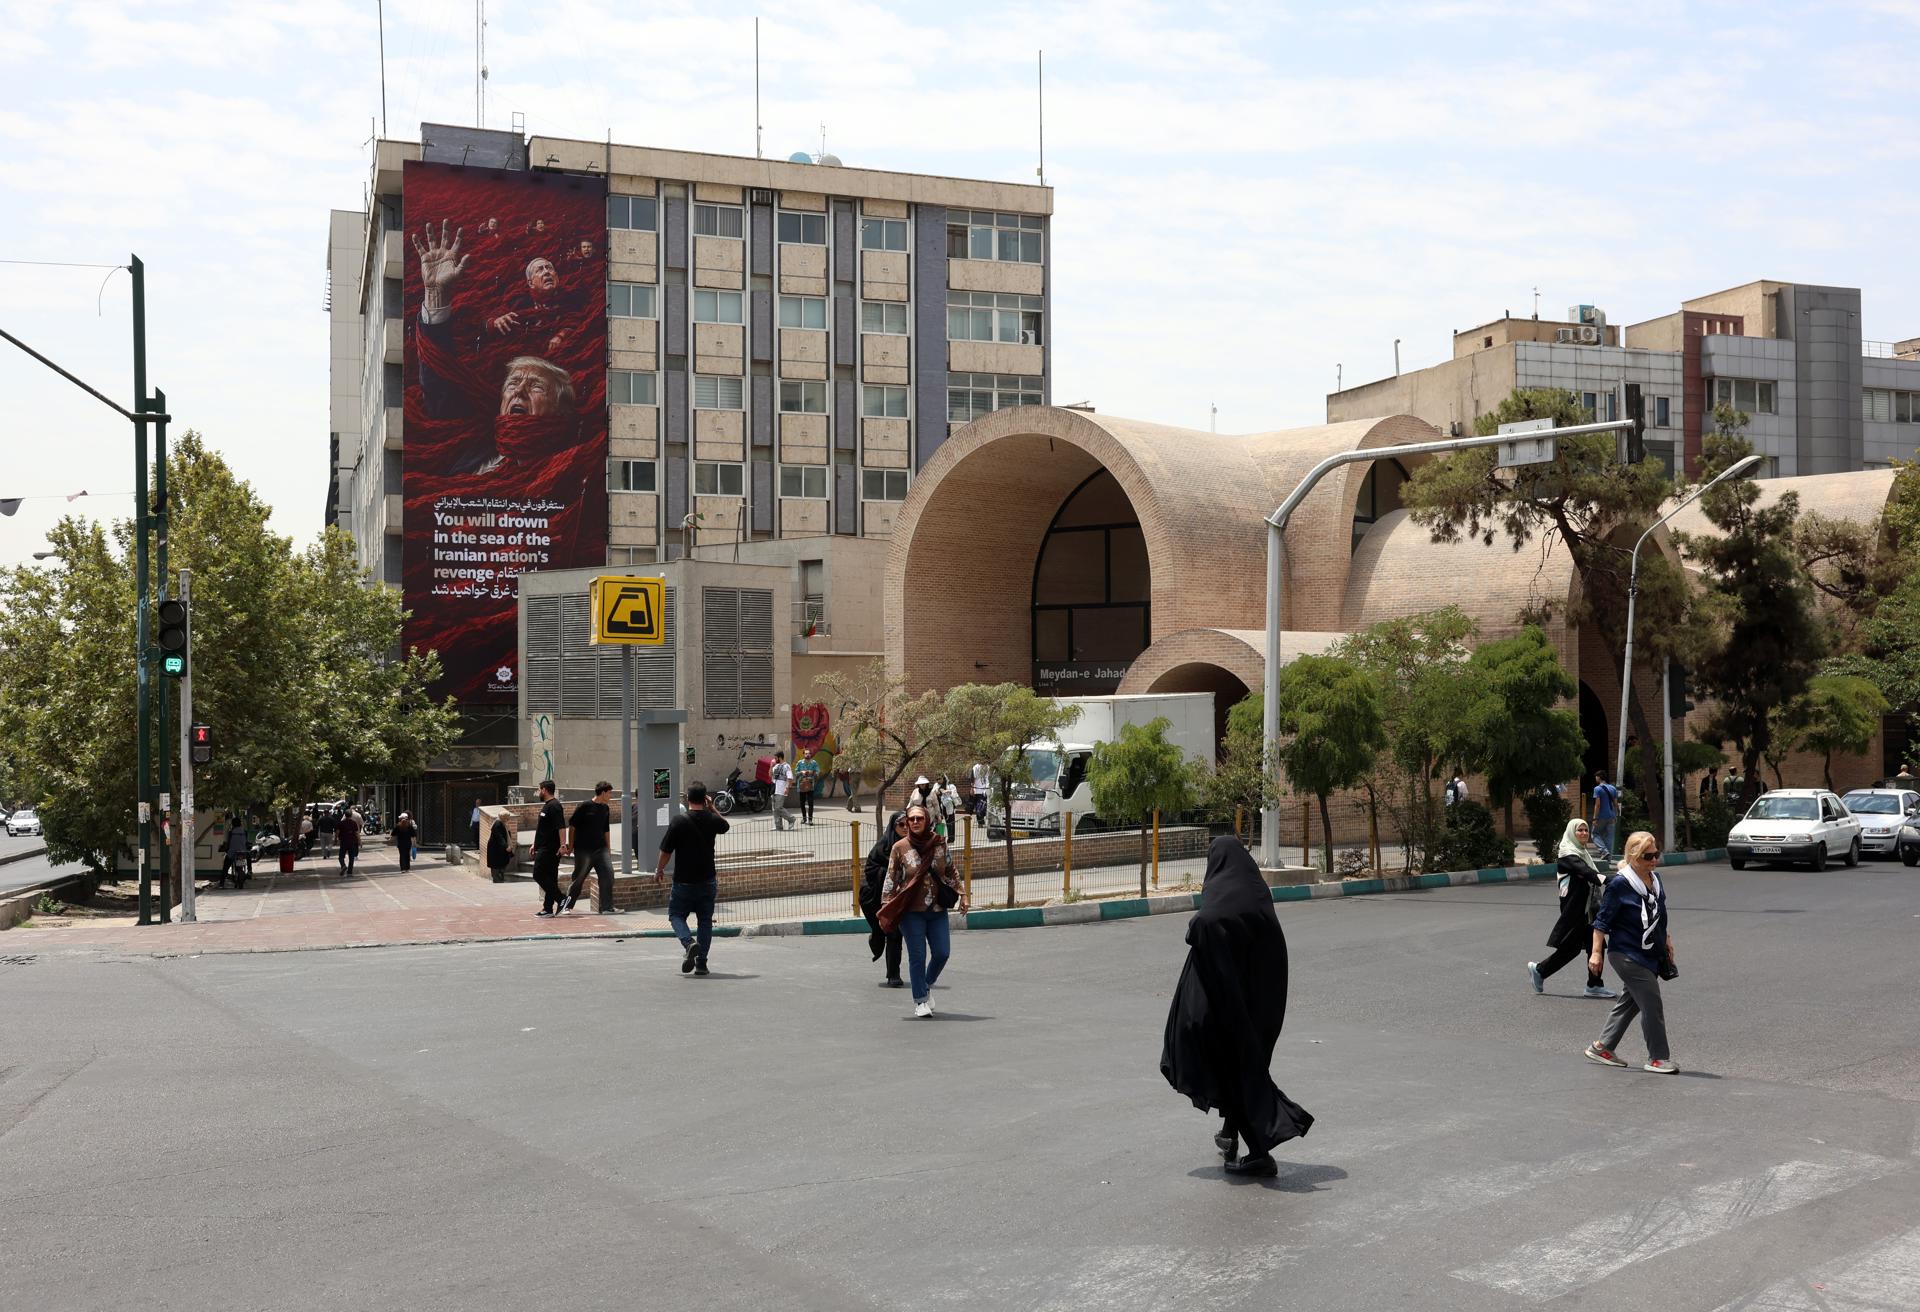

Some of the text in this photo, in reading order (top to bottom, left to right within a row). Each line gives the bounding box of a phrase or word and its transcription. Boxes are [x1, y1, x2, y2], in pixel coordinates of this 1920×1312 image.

[460, 498, 487, 511] الشعب
[487, 498, 507, 511] انتقام
[507, 501, 520, 511] بحر
[520, 498, 531, 513] في
[531, 499, 565, 511] ستغرقون
[434, 512, 548, 528] You will drown
[434, 530, 550, 546] in the sea of the
[434, 548, 549, 563] Iranian nation's
[434, 567, 494, 582] revenge
[431, 583, 449, 595] شد
[450, 582, 489, 598] خواهید
[491, 584, 511, 599] غرق
[1040, 668, 1126, 680] Meydan-e Jahad
